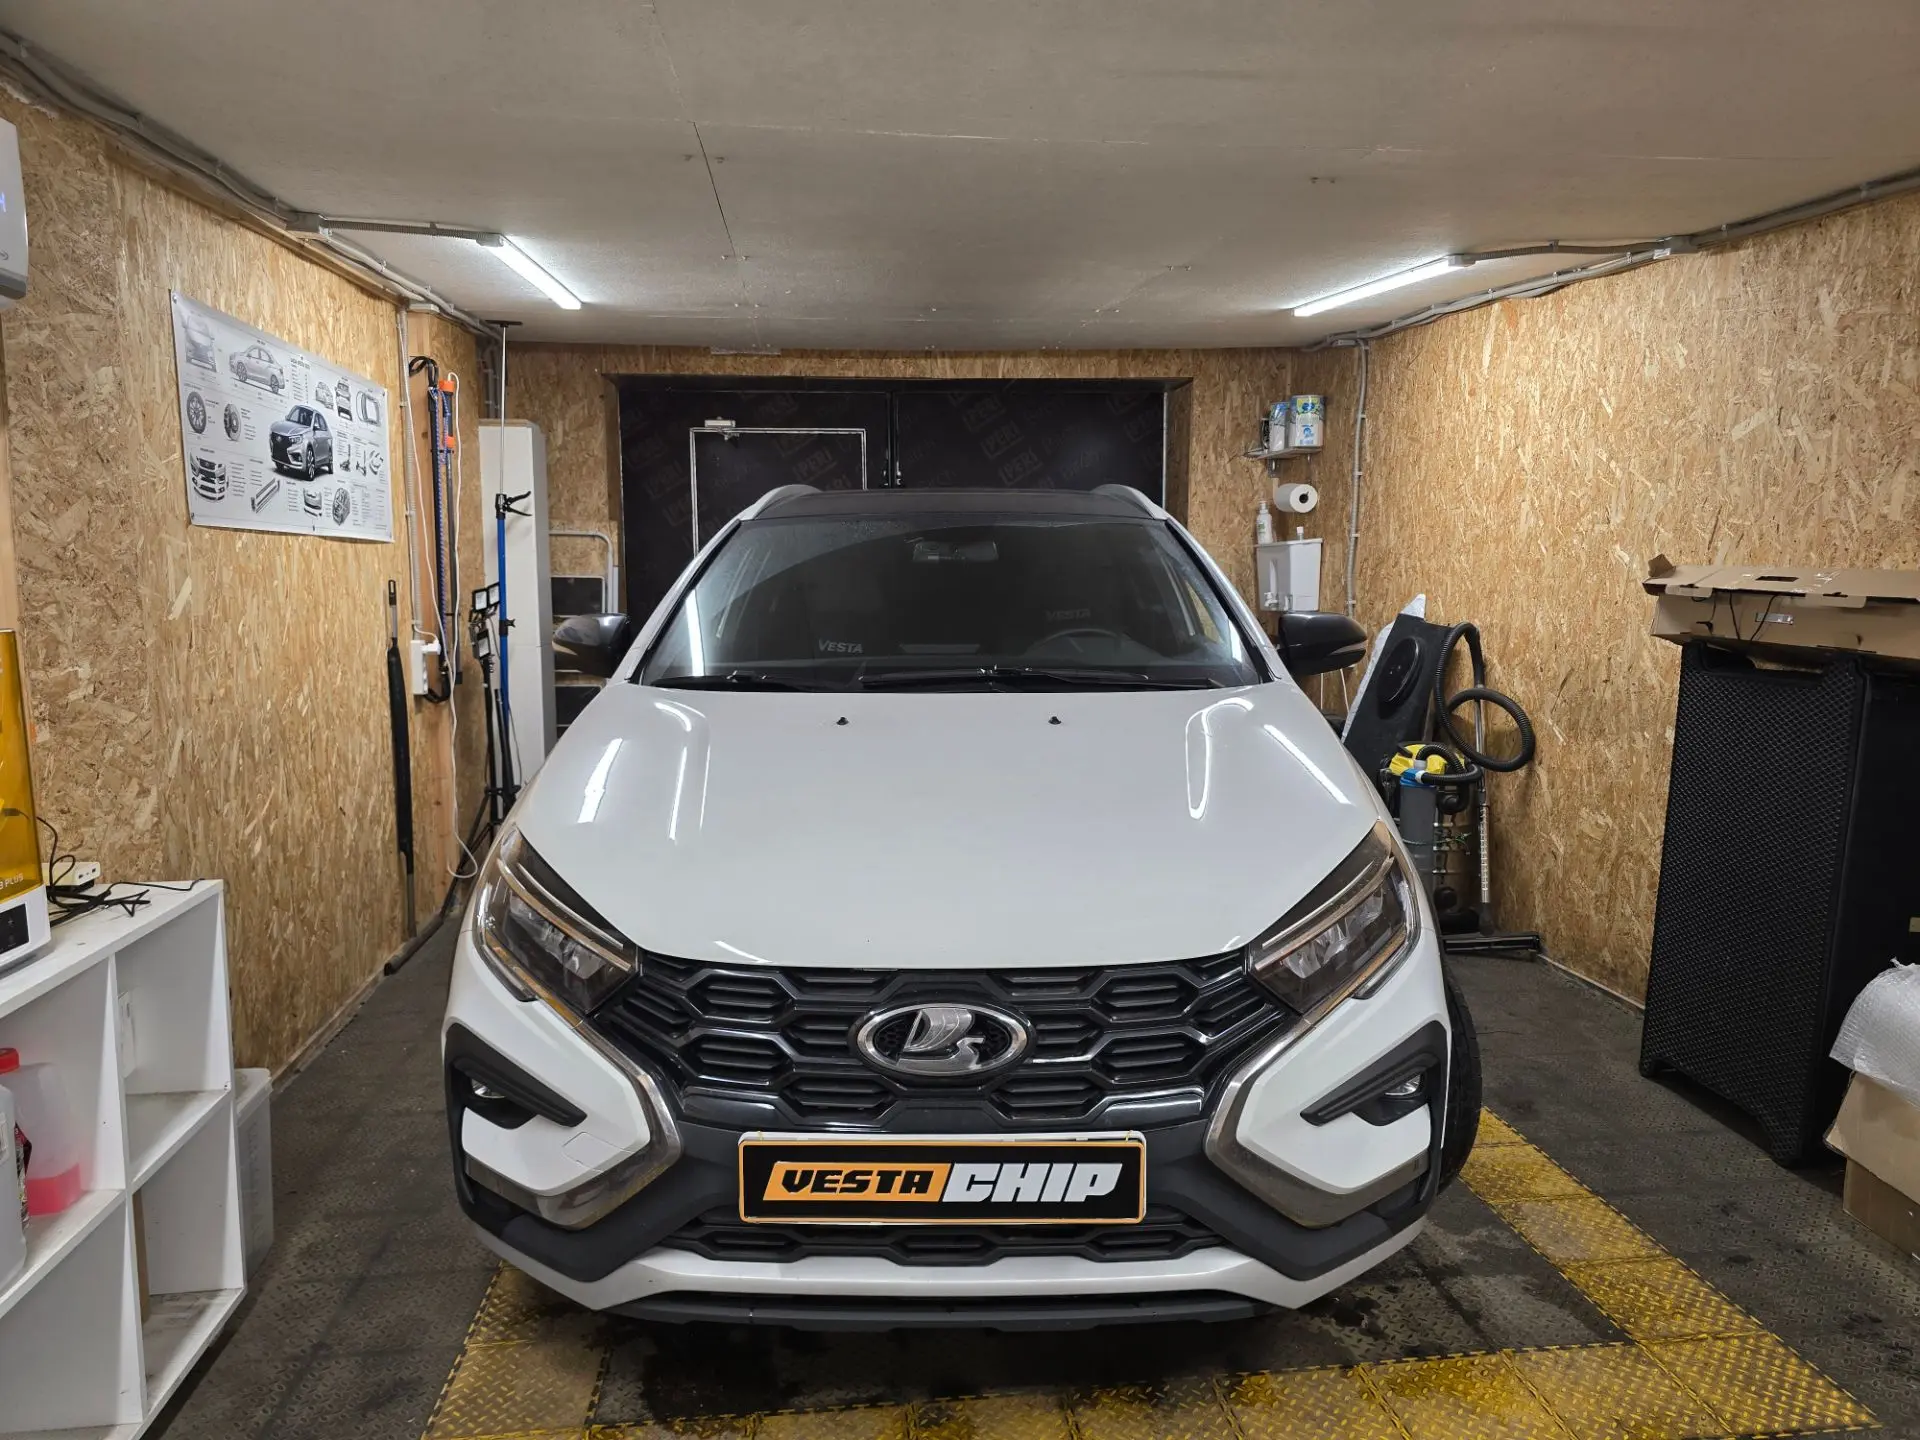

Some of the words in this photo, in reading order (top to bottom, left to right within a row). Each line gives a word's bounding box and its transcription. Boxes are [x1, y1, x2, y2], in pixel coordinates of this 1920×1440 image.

[984, 420, 1022, 452] PERI
[796, 445, 834, 478] PERI
[1002, 446, 1039, 480] PERI
[818, 638, 864, 654] VESTA
[5, 873, 24, 888] PLUS
[781, 1169, 935, 1195] VESTA
[942, 1162, 1123, 1203] CHIP
